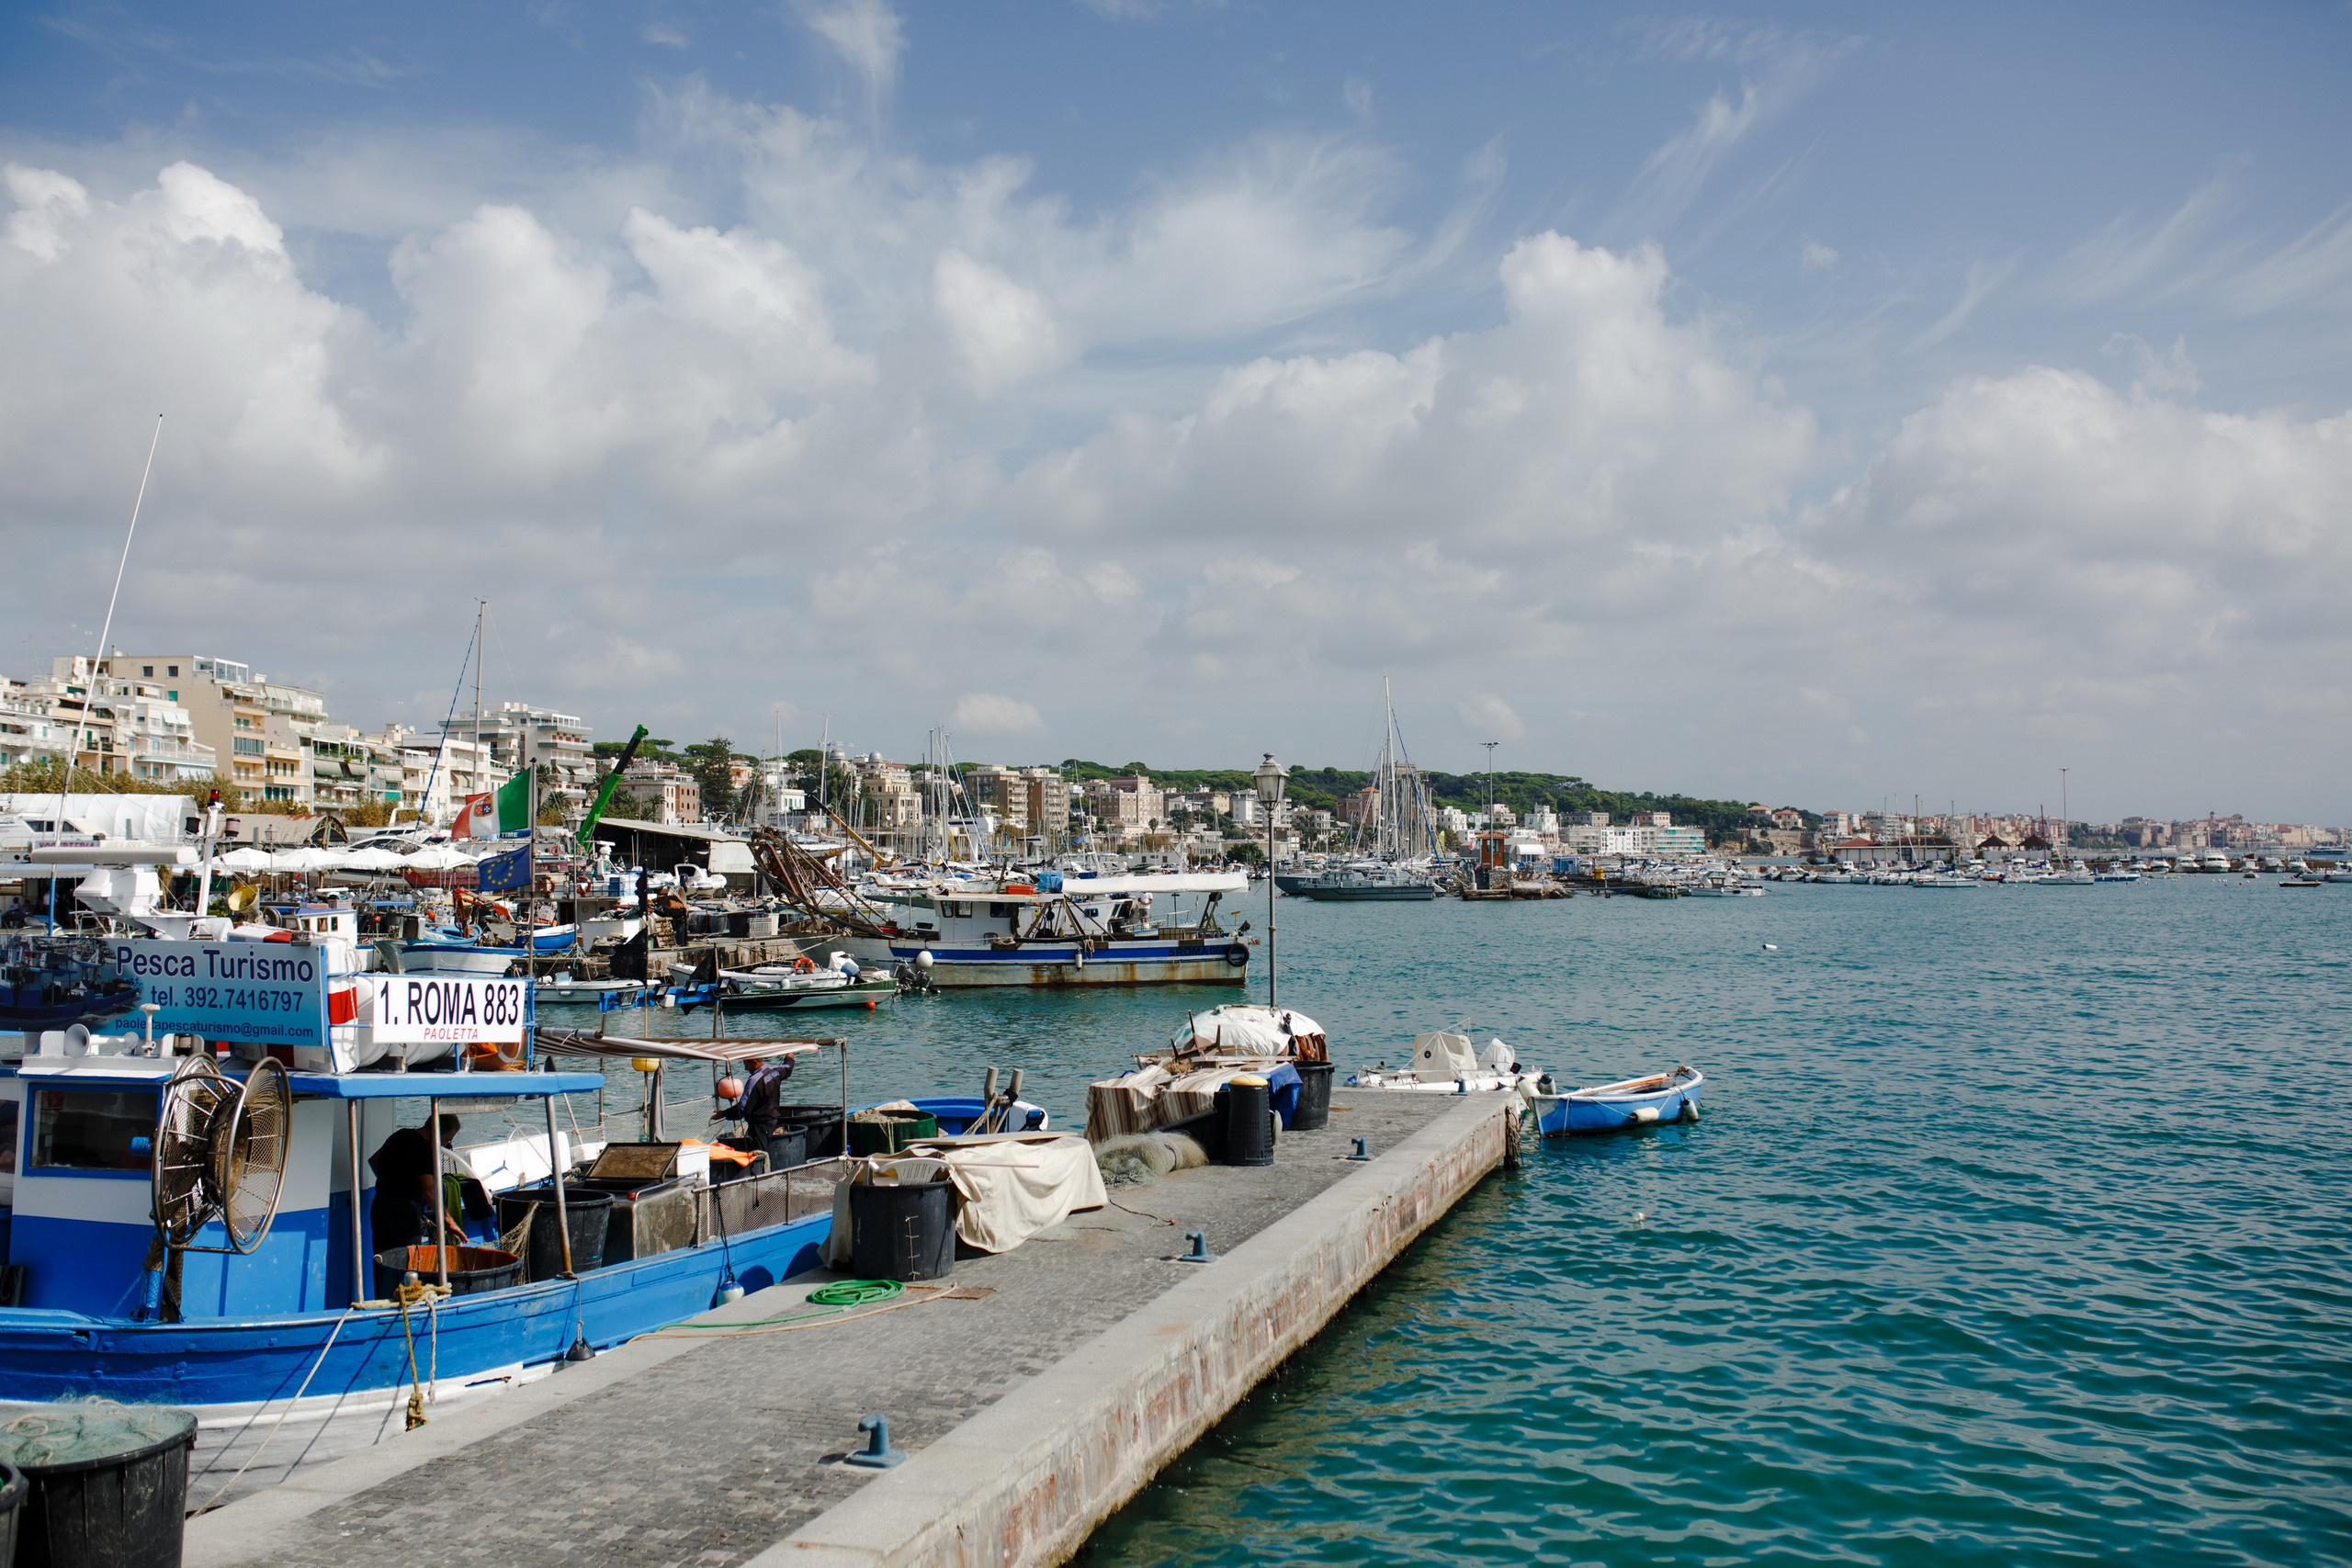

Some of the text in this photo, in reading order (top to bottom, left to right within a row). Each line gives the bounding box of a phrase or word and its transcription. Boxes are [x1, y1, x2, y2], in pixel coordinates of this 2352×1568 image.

[116, 946, 314, 982] Pesca Turismo
[151, 986, 303, 1012] tel. 392.7416797
[380, 981, 519, 1026] 1. ROMA 883
[115, 1018, 313, 1038] paoletapescaturismo@gmail.com
[424, 1028, 479, 1040] PAOLETTA
